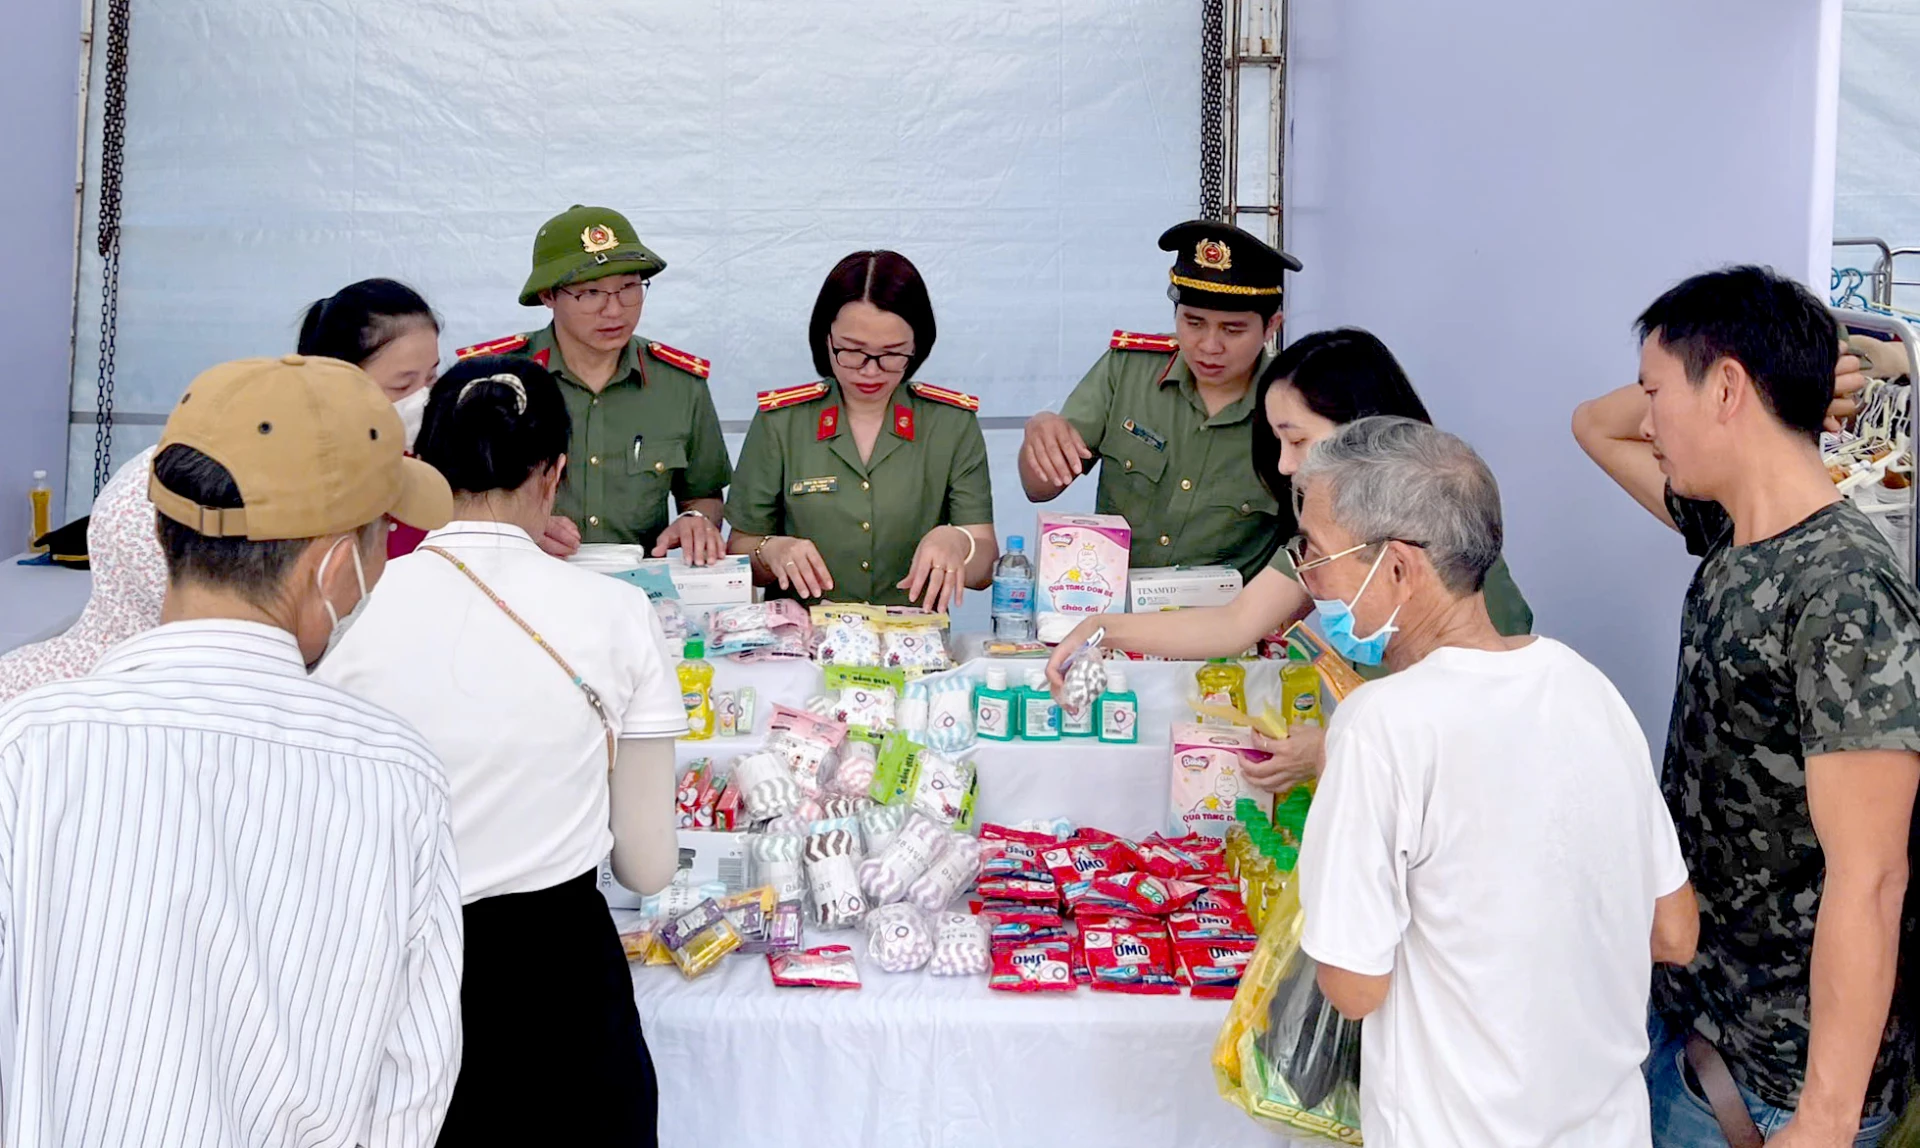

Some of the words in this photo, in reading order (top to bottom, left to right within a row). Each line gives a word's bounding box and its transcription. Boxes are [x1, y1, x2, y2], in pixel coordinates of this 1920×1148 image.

[1074, 857, 1105, 872] OMO
[1114, 944, 1148, 957] OMO
[1210, 947, 1238, 959] OM
